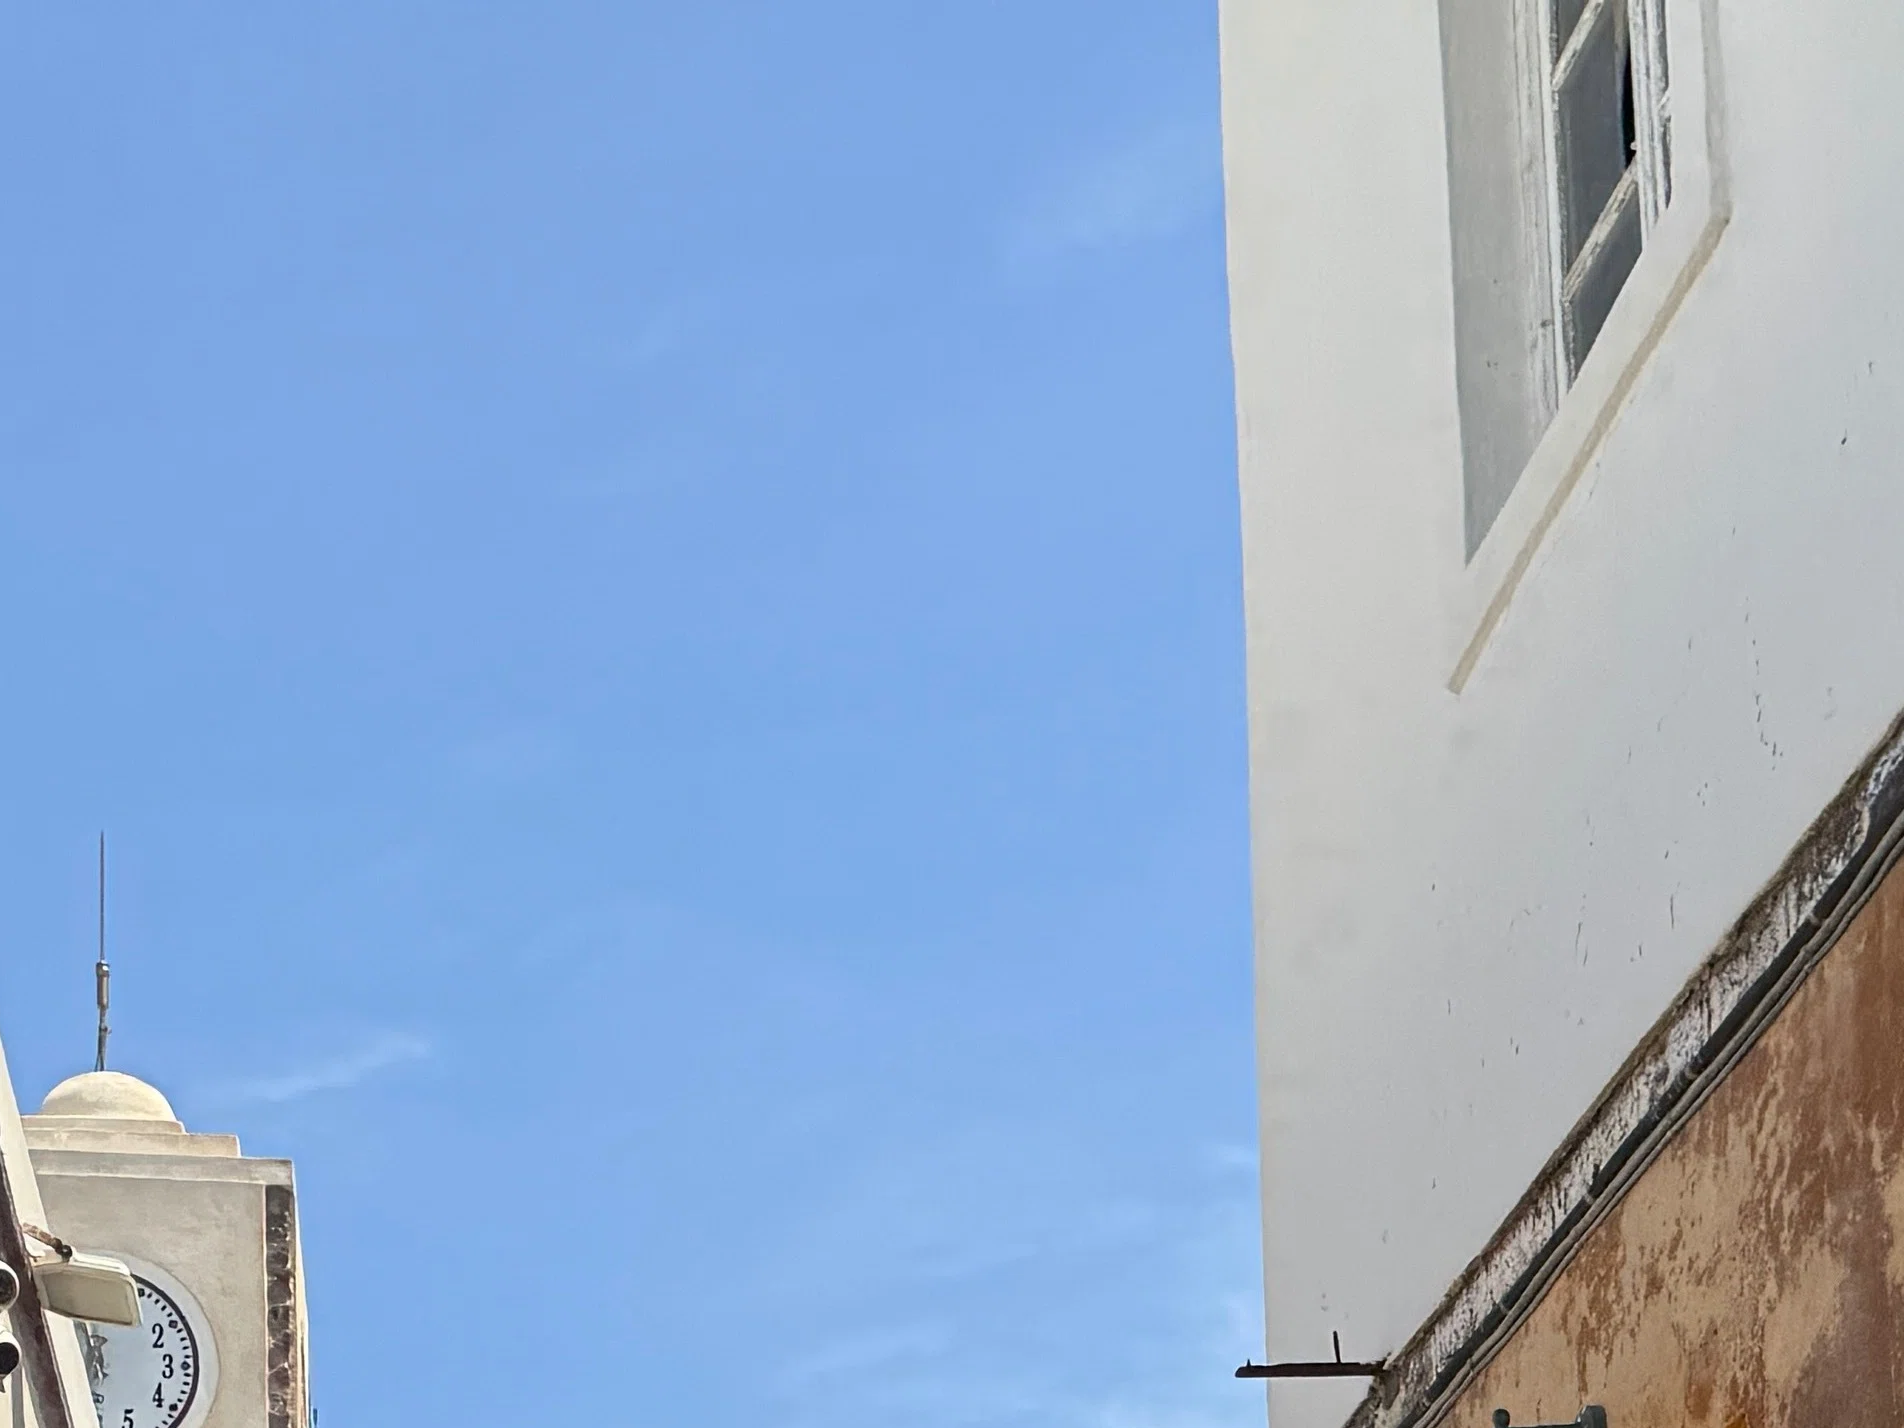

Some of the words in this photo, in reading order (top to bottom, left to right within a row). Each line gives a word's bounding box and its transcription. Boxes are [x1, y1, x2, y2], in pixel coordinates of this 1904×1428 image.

[151, 1323, 164, 1349] 2
[161, 1354, 174, 1379] 3
[152, 1382, 164, 1408] 4
